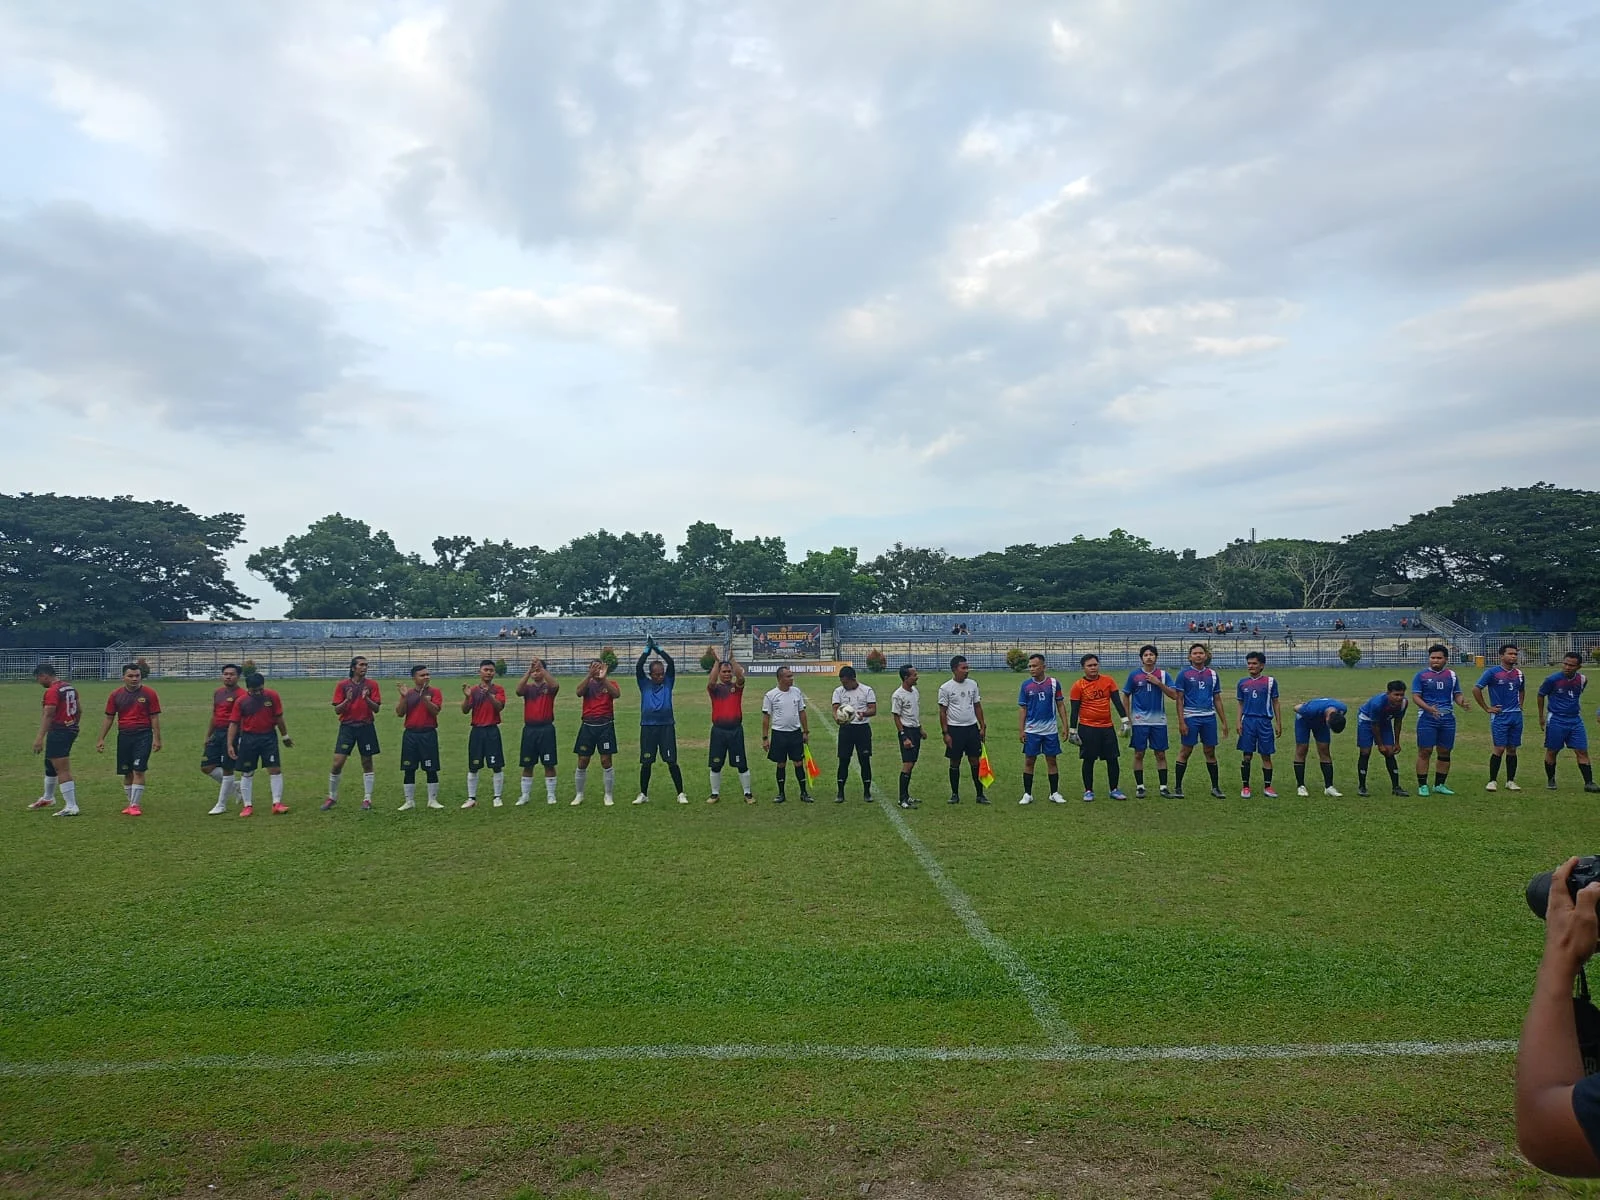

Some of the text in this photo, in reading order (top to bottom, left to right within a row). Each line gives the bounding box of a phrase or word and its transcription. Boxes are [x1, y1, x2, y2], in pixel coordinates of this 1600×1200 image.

[1198, 680, 1206, 689] 12
[1436, 681, 1444, 690] 10
[1508, 682, 1514, 691] 3
[1038, 691, 1046, 701] 13
[1092, 690, 1104, 699] 20
[1252, 690, 1258, 699] 6
[1567, 690, 1574, 698] 4
[65, 690, 77, 717] 13
